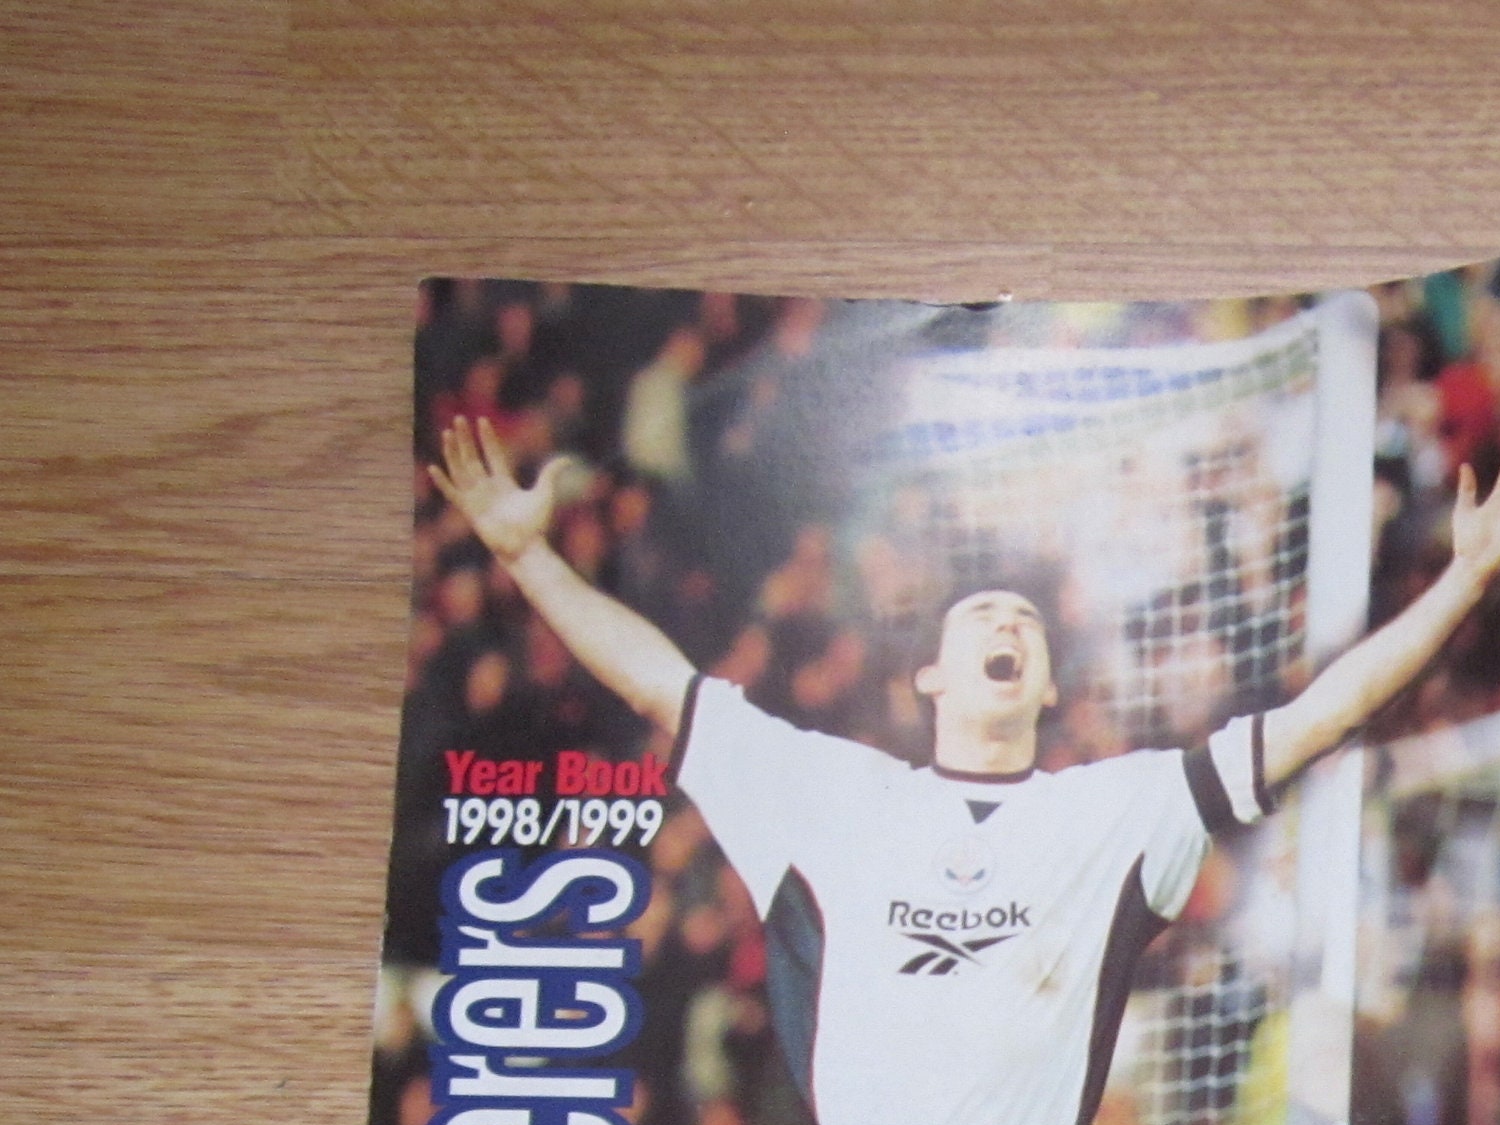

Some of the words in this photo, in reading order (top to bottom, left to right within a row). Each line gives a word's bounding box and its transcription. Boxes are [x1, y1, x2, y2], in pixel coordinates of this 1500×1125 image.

[445, 749, 544, 796] Year
[555, 749, 668, 797] Book
[442, 797, 664, 847] 1998/1999
[887, 899, 1032, 932] Reebok
